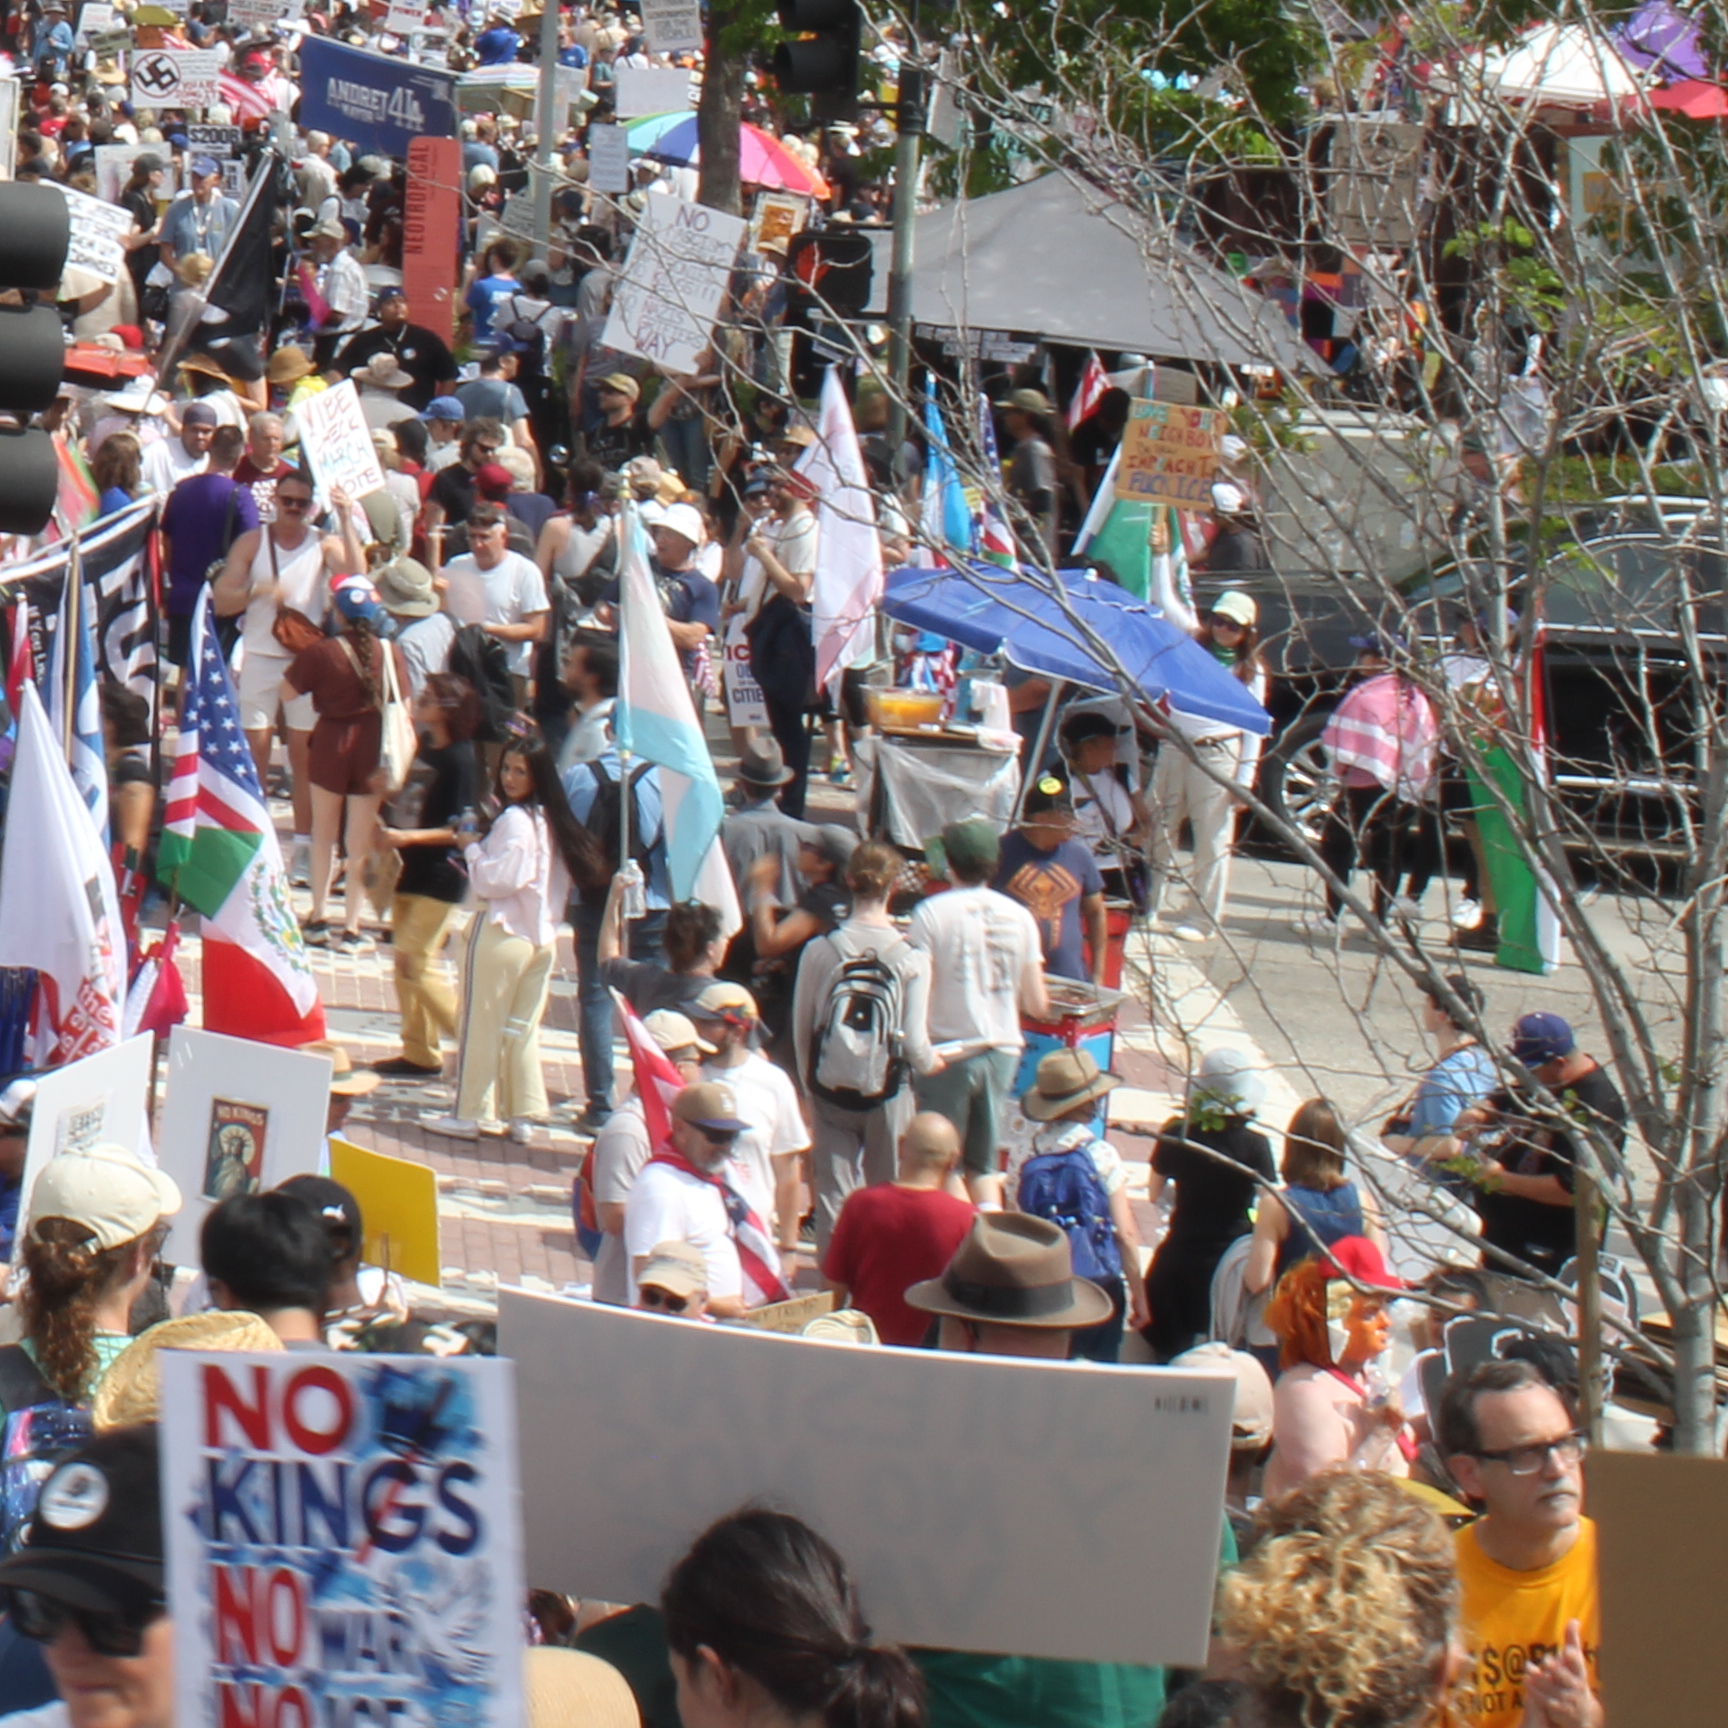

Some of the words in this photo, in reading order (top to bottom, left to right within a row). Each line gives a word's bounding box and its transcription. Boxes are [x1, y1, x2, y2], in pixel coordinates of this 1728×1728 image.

[404, 145, 430, 254] NEOTROPICAL
[674, 204, 710, 232] NO
[302, 387, 353, 428] VIBE
[1173, 475, 1210, 503] ICE
[726, 643, 753, 661] IC
[732, 687, 764, 704] CITIE
[217, 1105, 231, 1119] NO
[233, 1108, 265, 1125] KINGS
[200, 1363, 354, 1456] NO
[204, 1458, 479, 1556] KINGS
[215, 1566, 306, 1667] NO
